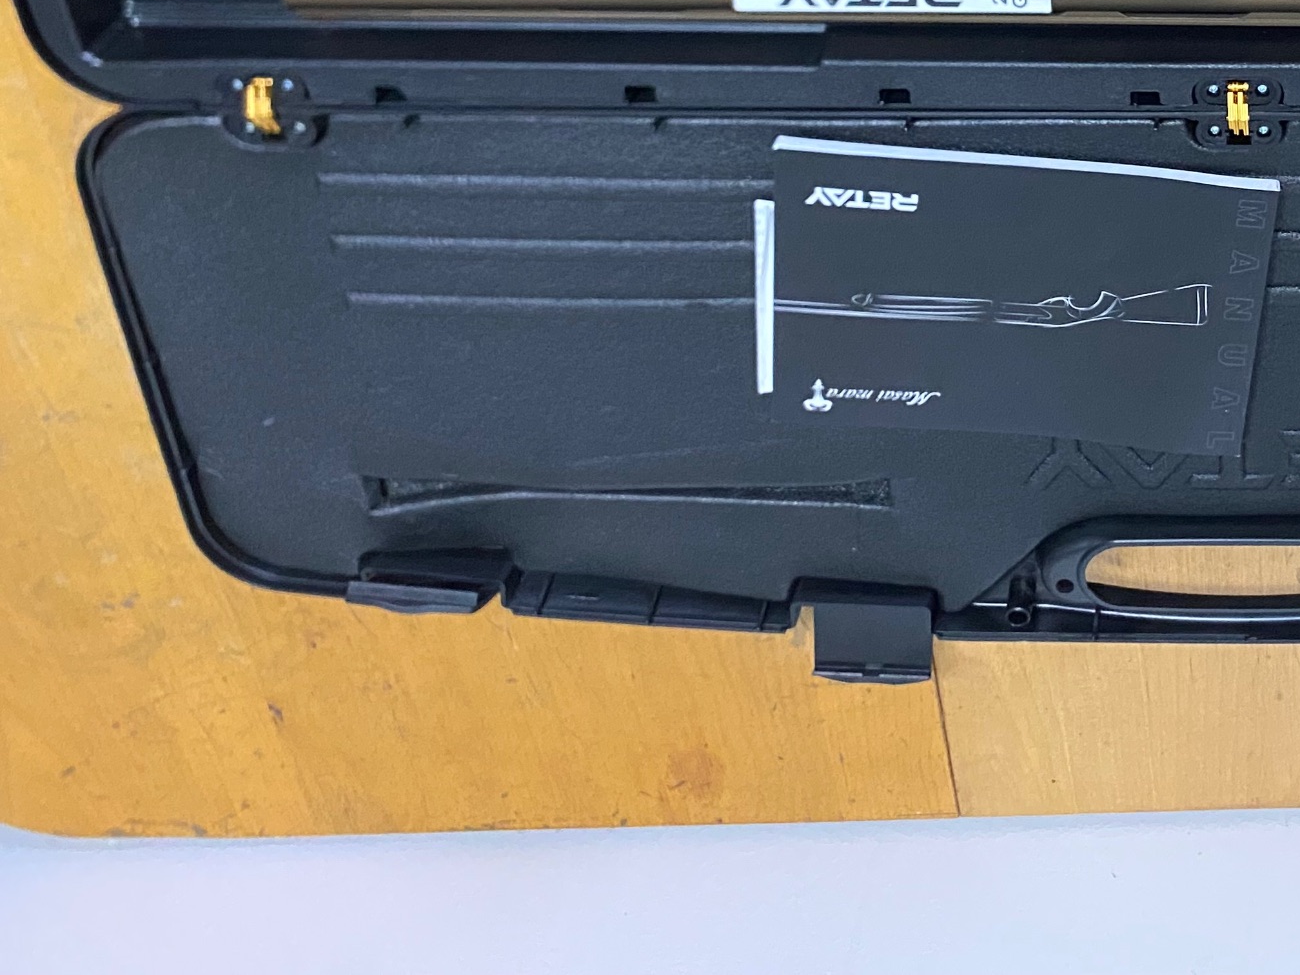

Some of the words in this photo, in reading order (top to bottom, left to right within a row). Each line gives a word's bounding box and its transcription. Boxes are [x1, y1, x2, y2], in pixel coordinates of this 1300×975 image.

[804, 186, 919, 213] RETAY
[1206, 199, 1268, 450] MANUAL
[825, 387, 874, 400] mara
[875, 389, 942, 406] Masai
